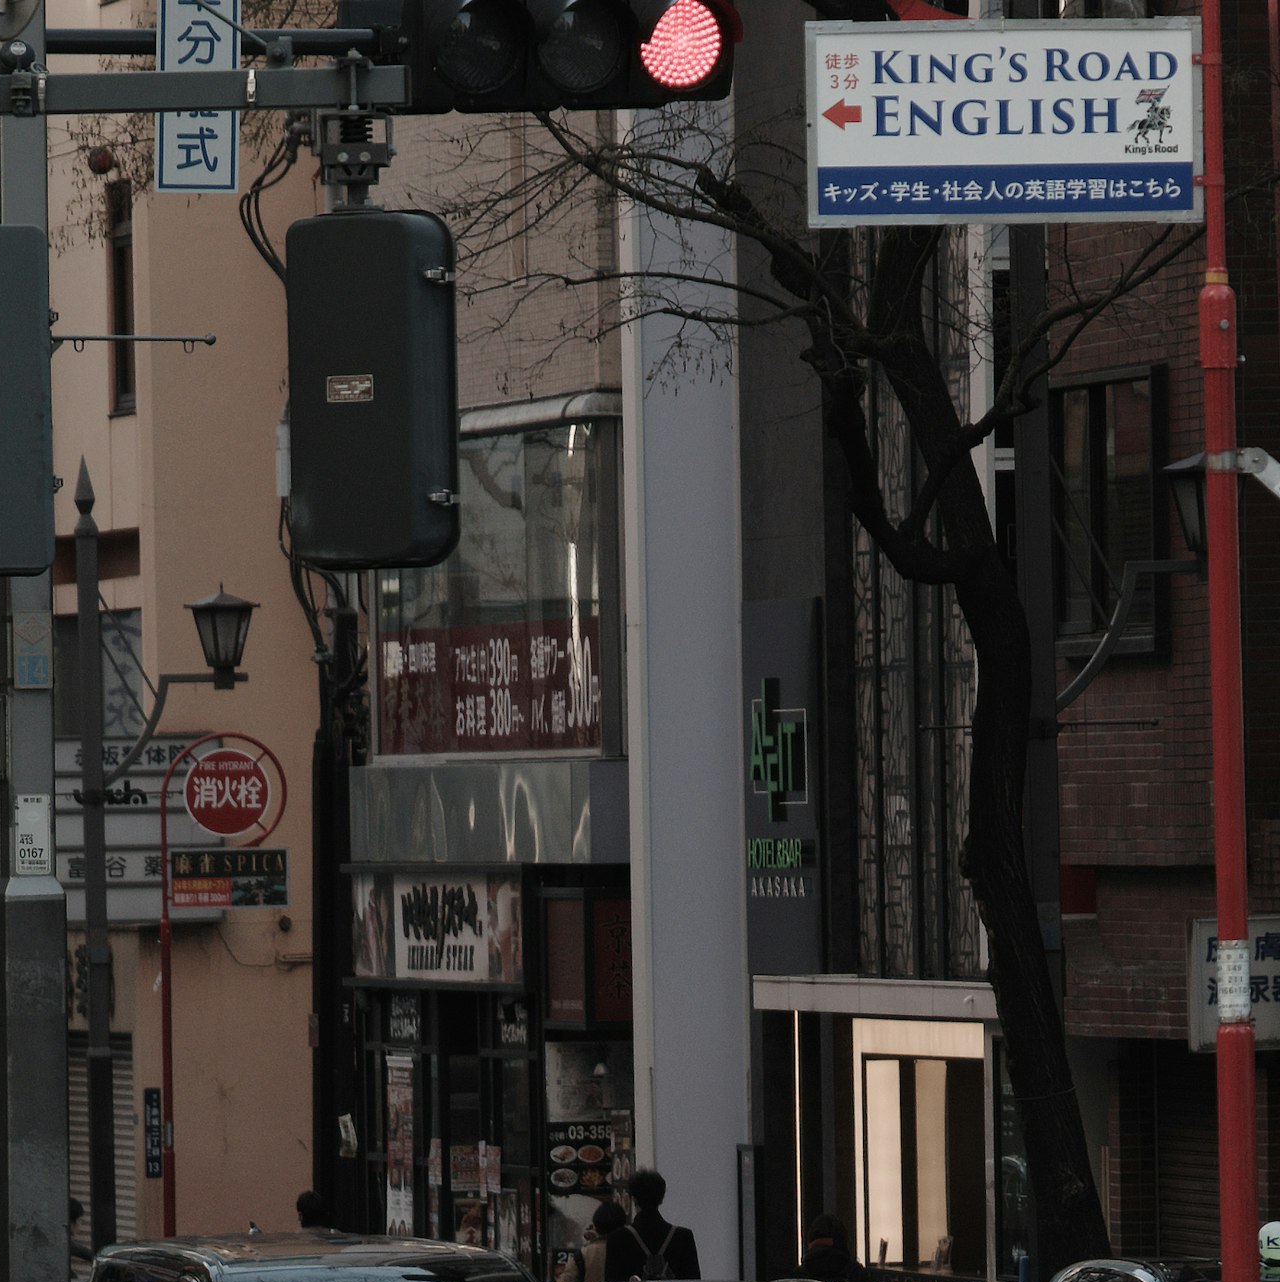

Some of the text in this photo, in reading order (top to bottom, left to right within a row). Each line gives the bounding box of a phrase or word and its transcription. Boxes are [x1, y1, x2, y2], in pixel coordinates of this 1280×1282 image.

[825, 53, 860, 71] 徒歩
[871, 47, 1179, 85] KING'S ROAD
[177, 0, 221, 172] 分式
[829, 74, 860, 90] 3分
[871, 95, 1121, 137] ENGLISH
[1124, 144, 1179, 156] King's Road
[824, 177, 1182, 203] キッズ・学生・社会人の英語学習はこちら
[198, 761, 255, 772] FIRE HYDRANT
[192, 776, 263, 810] 消火栓
[19, 848, 44, 859] 0167
[224, 853, 285, 872] SPICA
[751, 875, 806, 897] AKASAKA
[148, 1161, 160, 1173] 13
